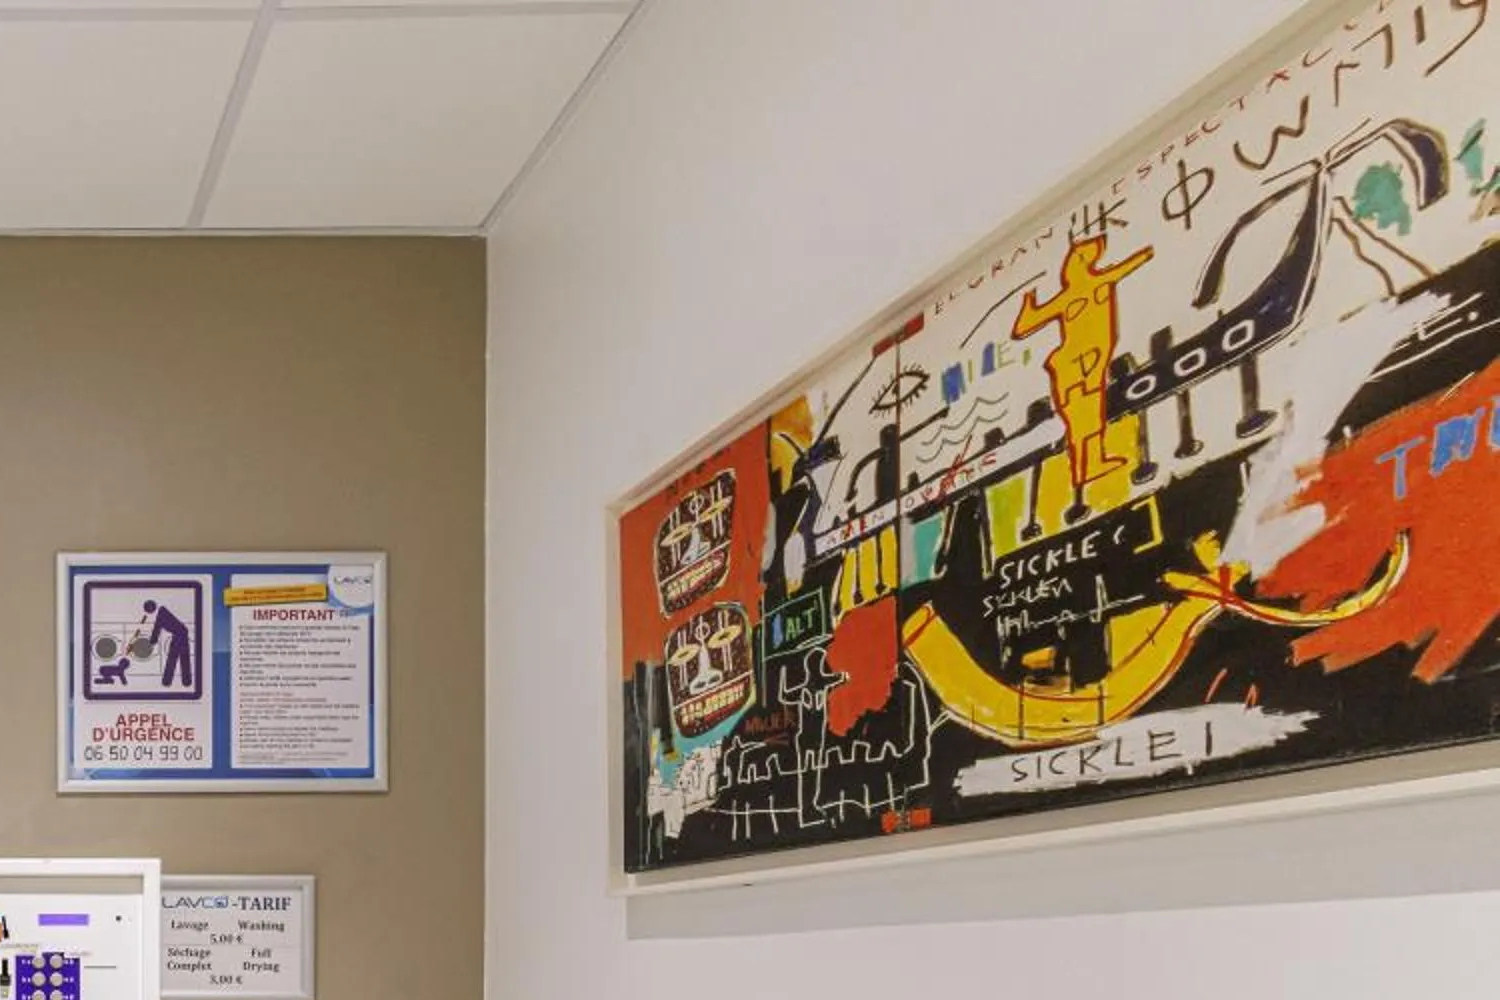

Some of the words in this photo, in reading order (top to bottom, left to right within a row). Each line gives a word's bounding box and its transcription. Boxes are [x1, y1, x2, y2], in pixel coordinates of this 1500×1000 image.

[252, 608, 336, 621] IMPORTANT
[116, 713, 173, 727] APPEL
[92, 727, 196, 742] D'URGENCE
[83, 745, 104, 761] 06
[109, 745, 129, 761] 50
[133, 745, 154, 761] 04
[159, 745, 179, 761] 99
[1011, 729, 1181, 783] SICKLE
[171, 920, 209, 933] Lavage
[238, 920, 285, 933] Washing
[251, 947, 272, 959] Full
[167, 960, 212, 973] Complet
[243, 960, 280, 973] Drying
